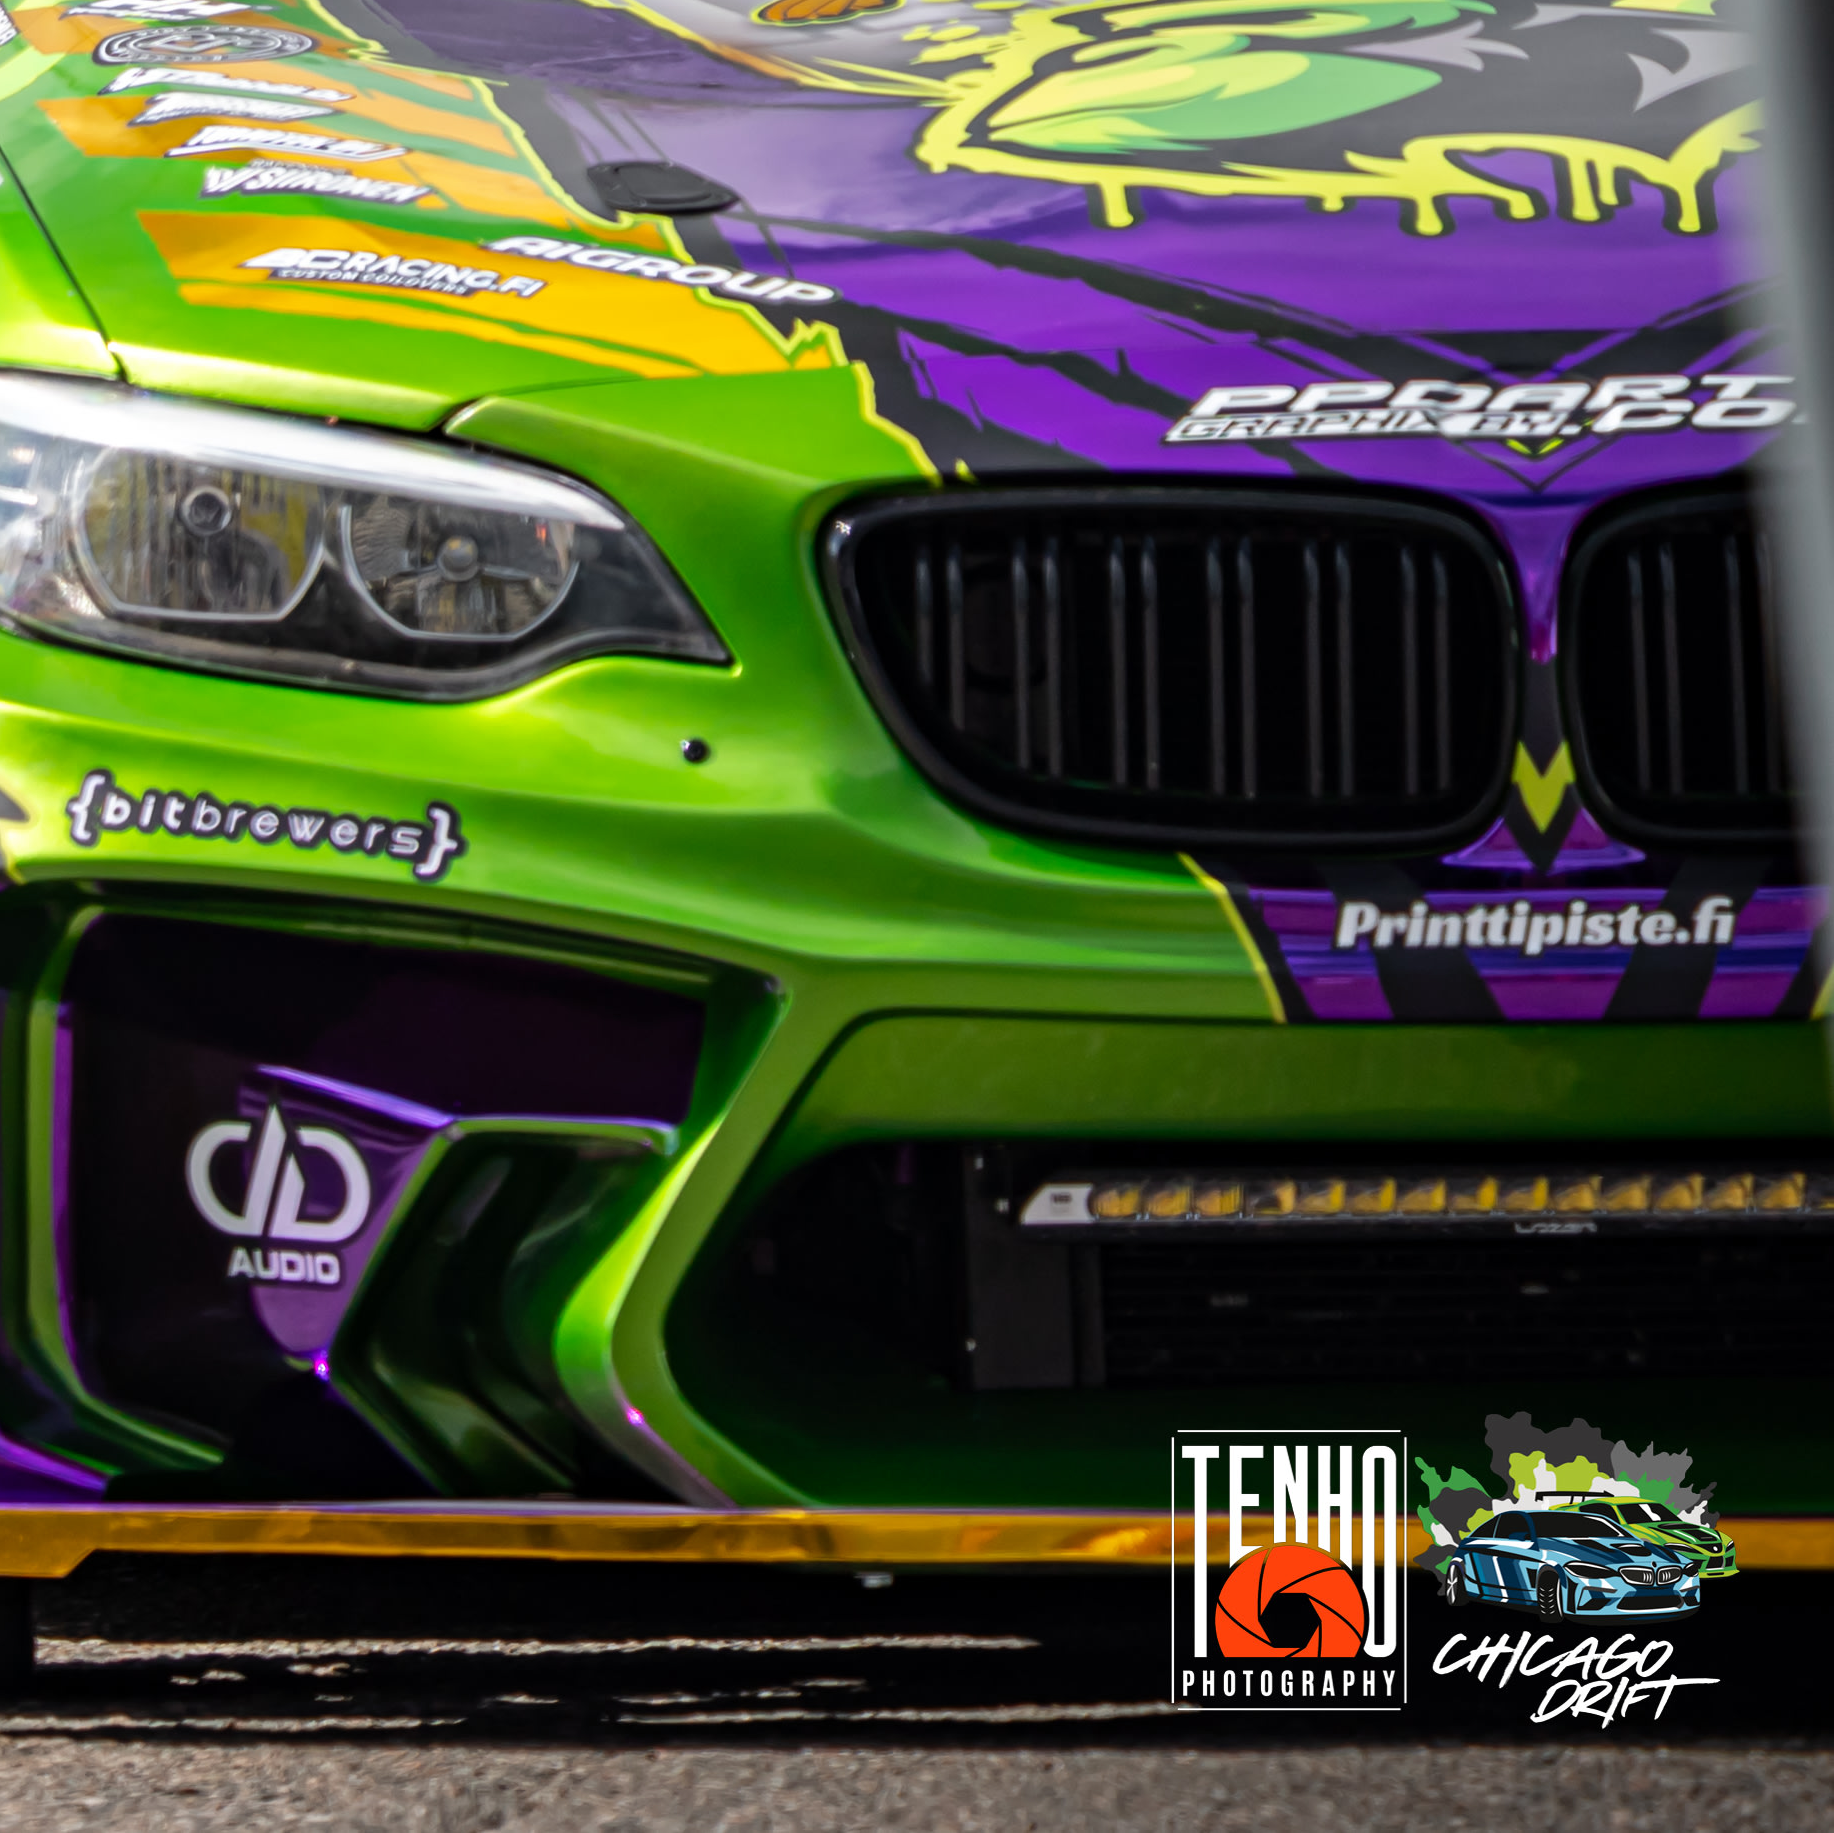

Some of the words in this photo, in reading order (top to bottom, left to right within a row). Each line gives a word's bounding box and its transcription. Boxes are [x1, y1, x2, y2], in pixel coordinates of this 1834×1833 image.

[280, 269, 358, 282] CUSTOM
[1336, 898, 1735, 954] Printtipiste.fi
[228, 1247, 340, 1284] AUDIO
